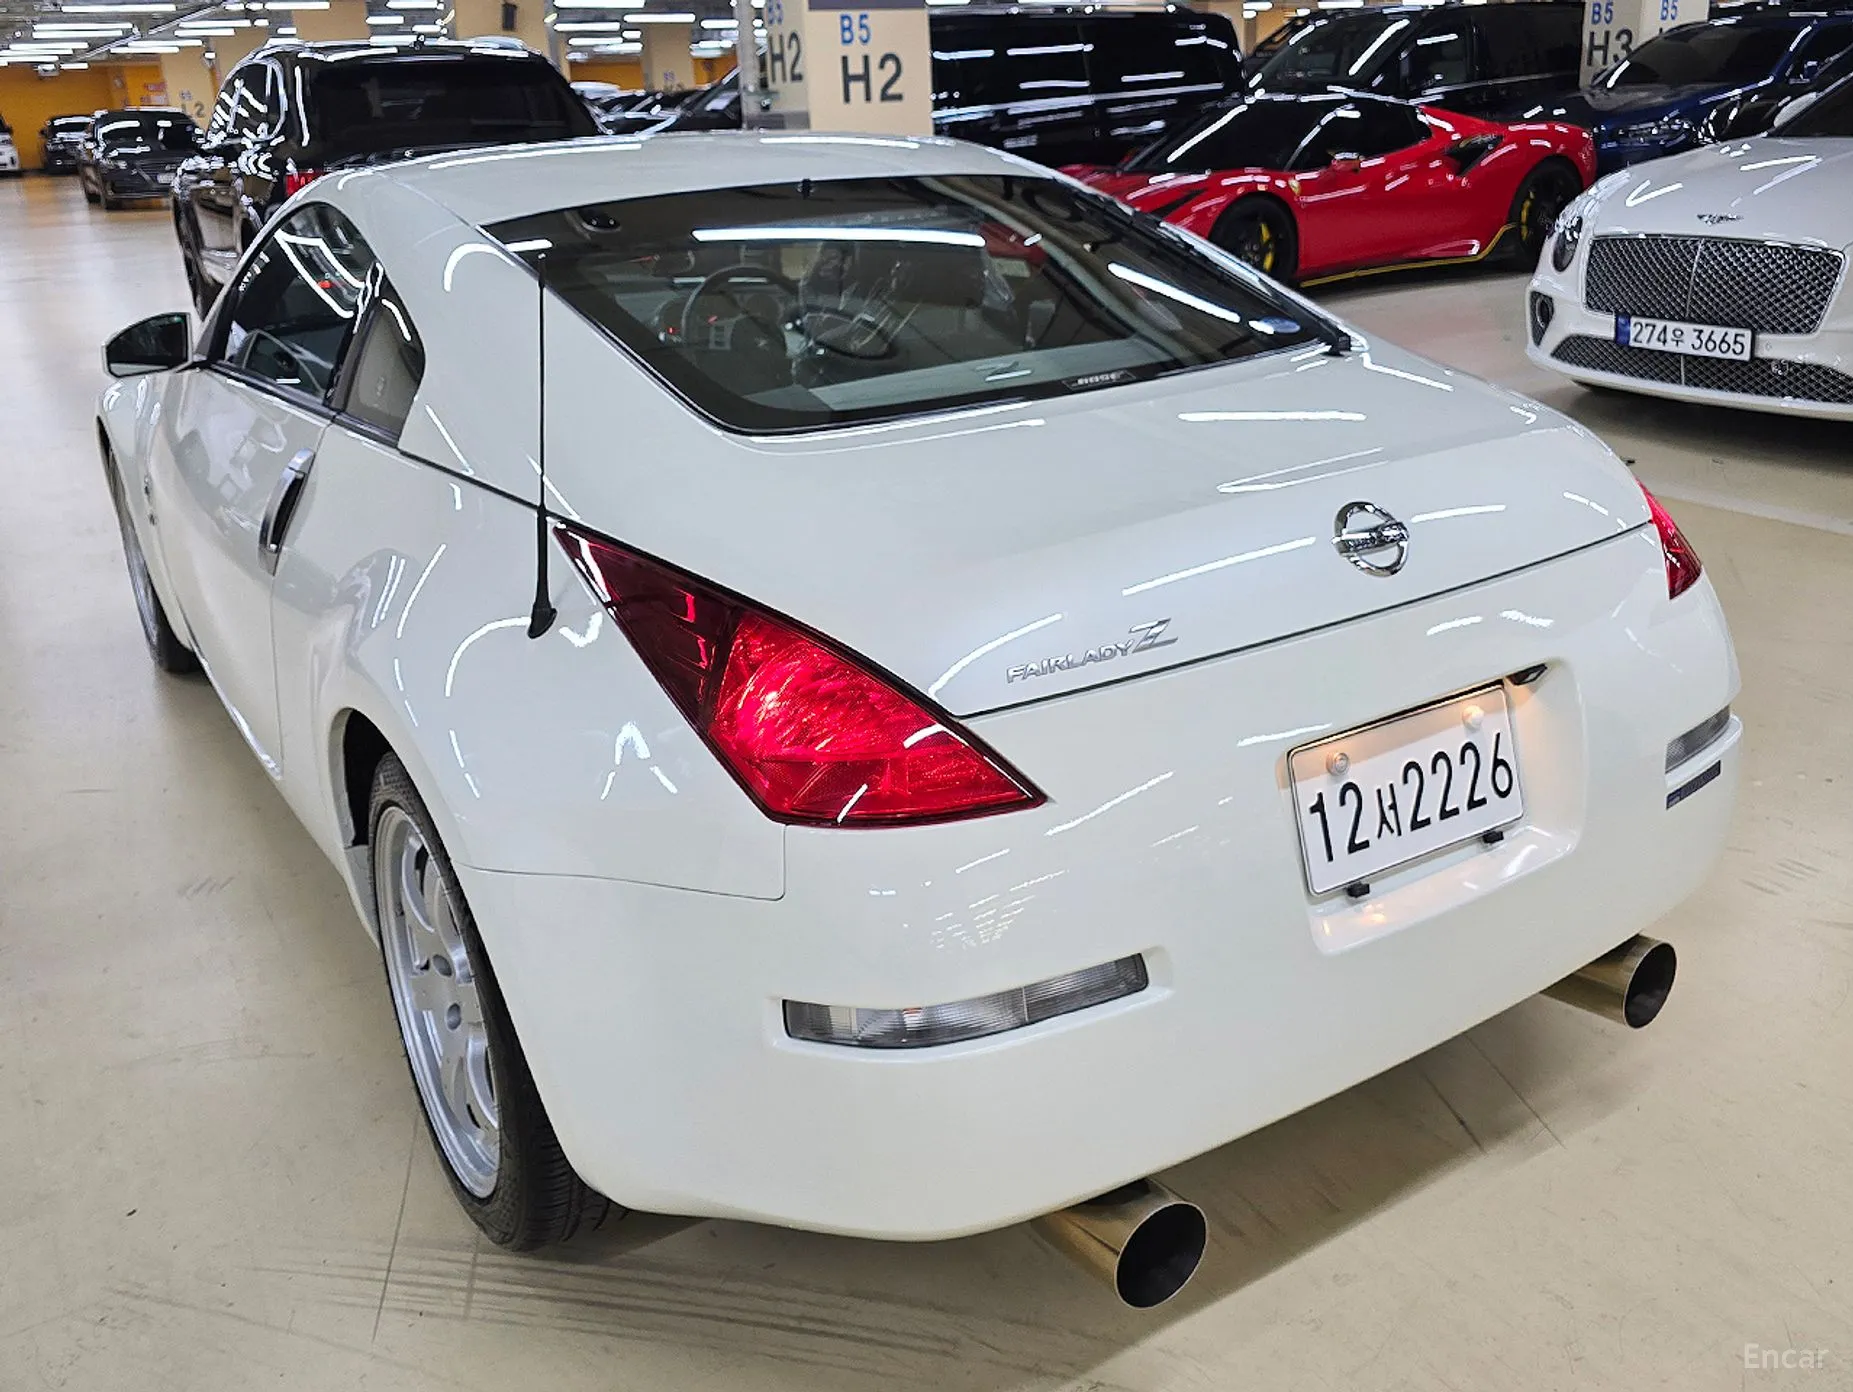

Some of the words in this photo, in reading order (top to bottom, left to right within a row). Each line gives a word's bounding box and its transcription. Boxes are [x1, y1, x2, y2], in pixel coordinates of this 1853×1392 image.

[840, 14, 871, 45] B5
[1591, 1, 1614, 25] B5
[1660, 0, 1678, 20] B5
[768, 32, 803, 84] H2
[1587, 27, 1633, 66] H3
[841, 53, 903, 103] H2
[1007, 640, 1134, 683] FAIRLADY
